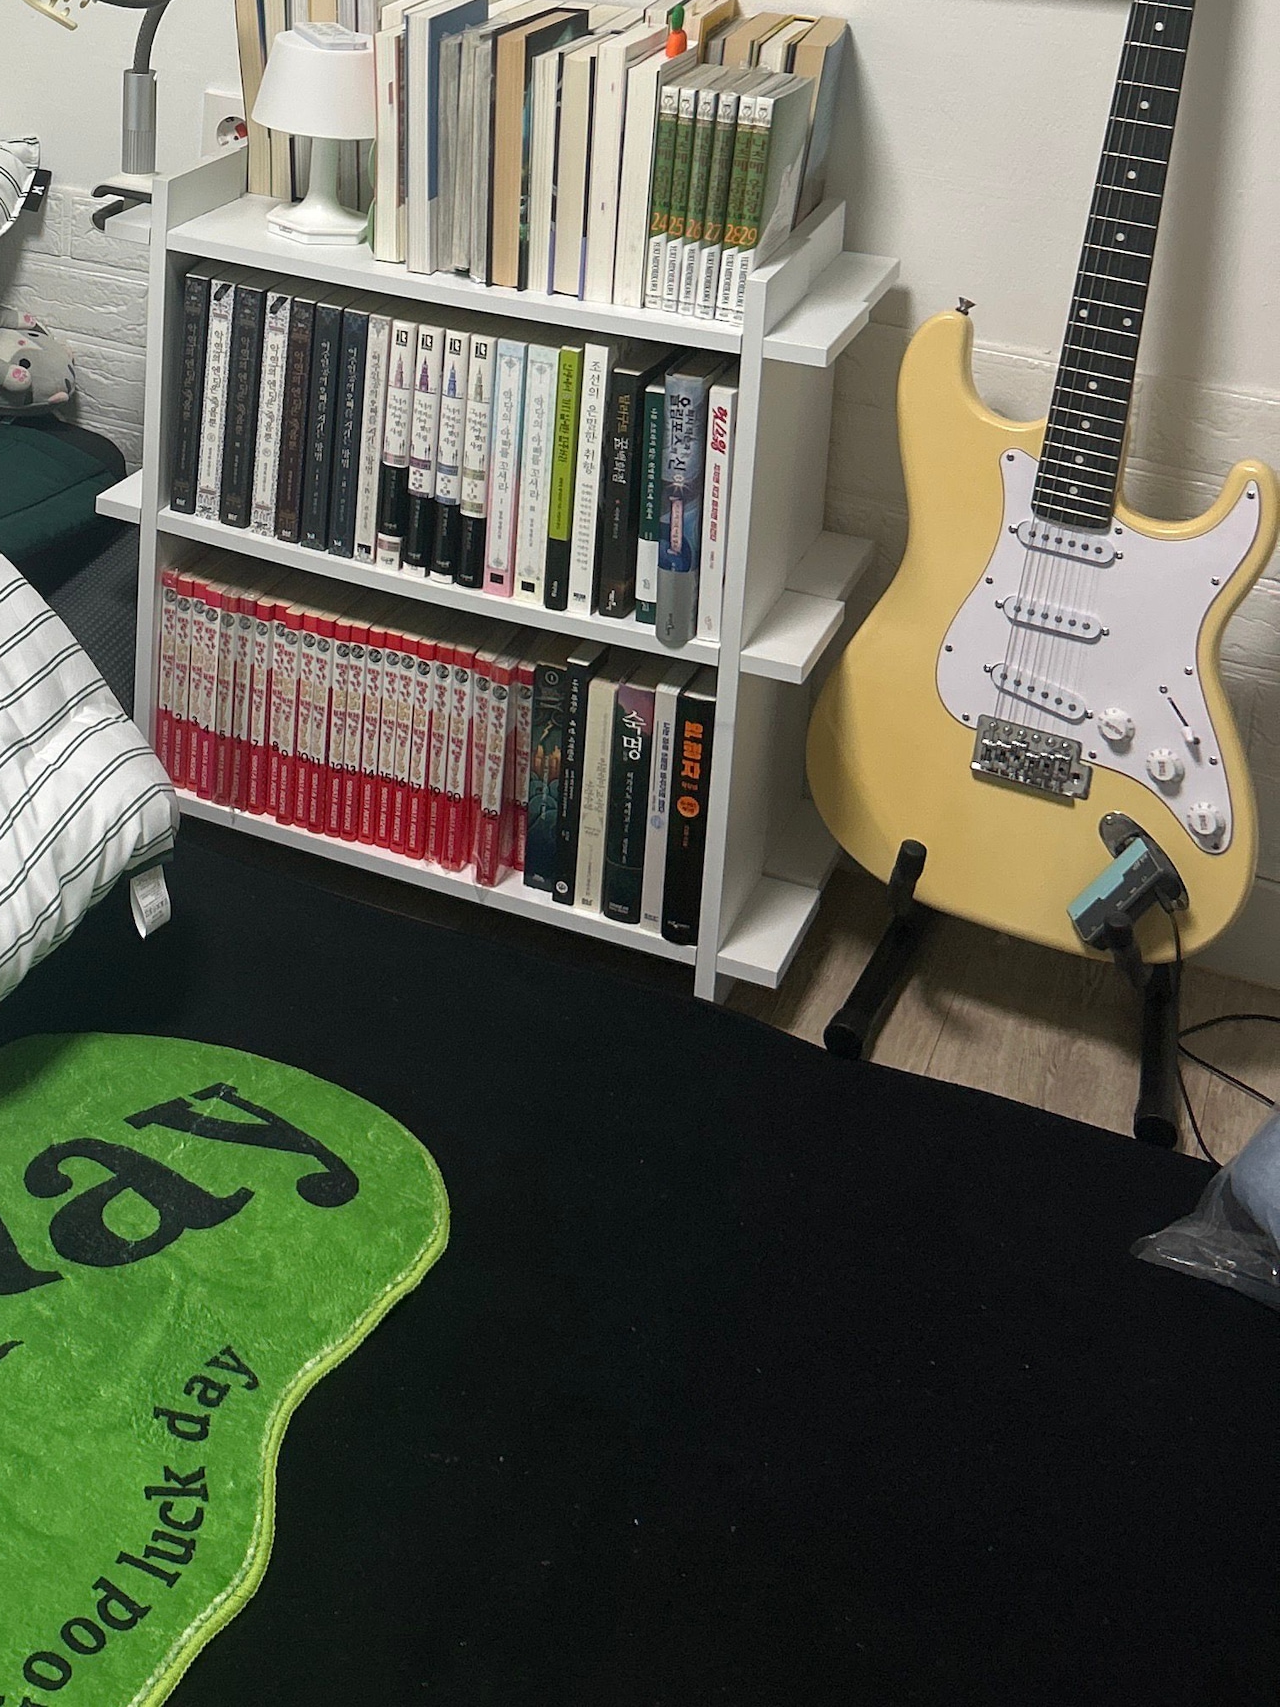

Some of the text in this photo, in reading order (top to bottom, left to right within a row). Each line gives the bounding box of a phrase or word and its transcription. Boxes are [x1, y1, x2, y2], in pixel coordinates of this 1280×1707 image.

[651, 213, 667, 230] 24
[669, 216, 684, 235] 25
[686, 219, 702, 238] 26
[705, 222, 721, 241] 27
[724, 224, 740, 244] 28
[739, 226, 757, 245] 29
[588, 361, 600, 399] 조선의
[585, 404, 598, 443] 은밀한
[583, 448, 595, 476] 취향
[668, 457, 687, 472] 신
[163, 704, 168, 714] 1
[176, 713, 182, 723] 2
[192, 716, 198, 726] 3
[203, 725, 210, 735] 4
[220, 731, 226, 741] 5
[622, 710, 647, 761] 숙명
[252, 739, 259, 749] 7
[272, 741, 279, 752] 8
[281, 750, 289, 760] 9
[297, 751, 309, 763] 10
[311, 755, 321, 769] 11
[331, 762, 343, 773] 12
[346, 764, 357, 776] 13
[363, 768, 374, 780] 14
[380, 771, 392, 783] 15
[395, 775, 406, 788] 16
[410, 781, 421, 793] 17
[447, 791, 461, 803] 20
[474, 794, 481, 803] 2
[483, 808, 498, 820] 22
[153, 1345, 260, 1441] day
[115, 1465, 209, 1588] luck
